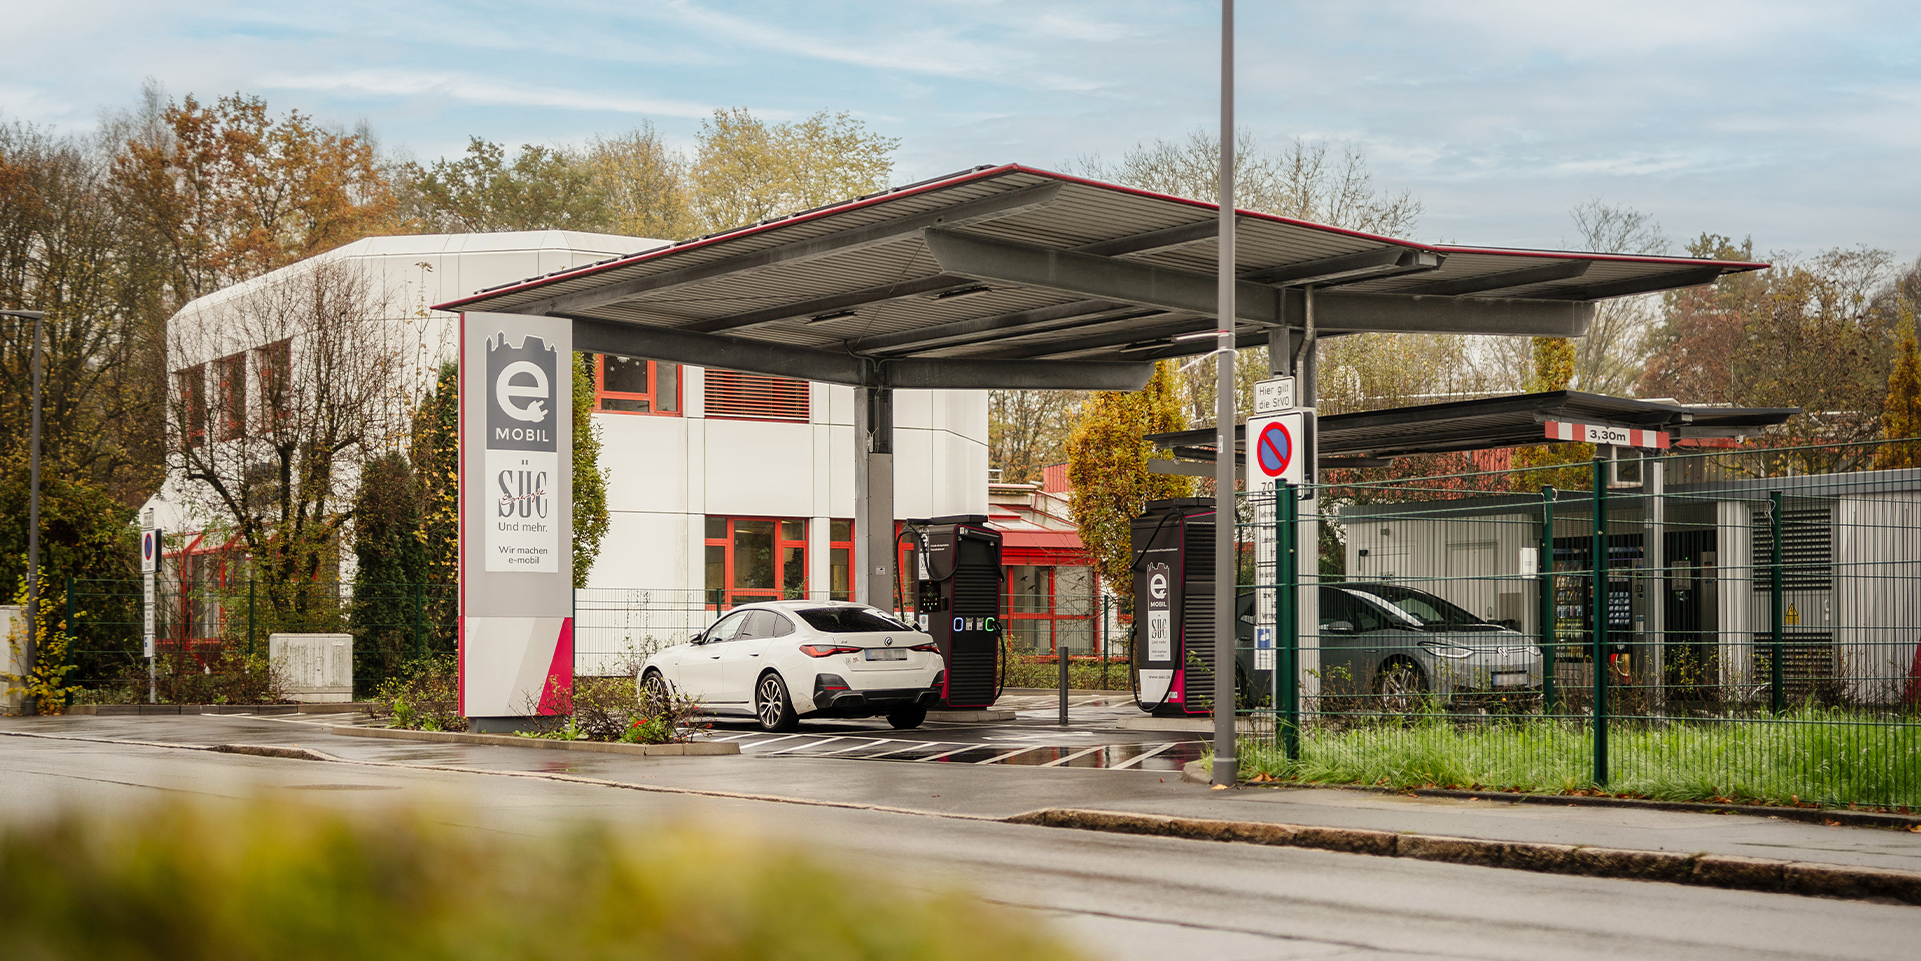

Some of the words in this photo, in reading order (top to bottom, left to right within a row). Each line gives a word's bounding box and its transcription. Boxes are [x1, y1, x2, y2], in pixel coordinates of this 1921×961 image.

[496, 360, 549, 422] e
[1259, 385, 1274, 396] Hier
[1277, 383, 1289, 396] gilt
[1259, 400, 1270, 409] die
[1272, 396, 1290, 407] StVO
[495, 427, 549, 442] MOBIL
[1589, 429, 1626, 442] 3,30m
[498, 459, 548, 519] SÜC
[498, 521, 519, 532] Und
[522, 521, 548, 533] mehr.
[498, 545, 515, 554] Wir
[517, 546, 548, 555] machen
[508, 556, 540, 565] e-mobil
